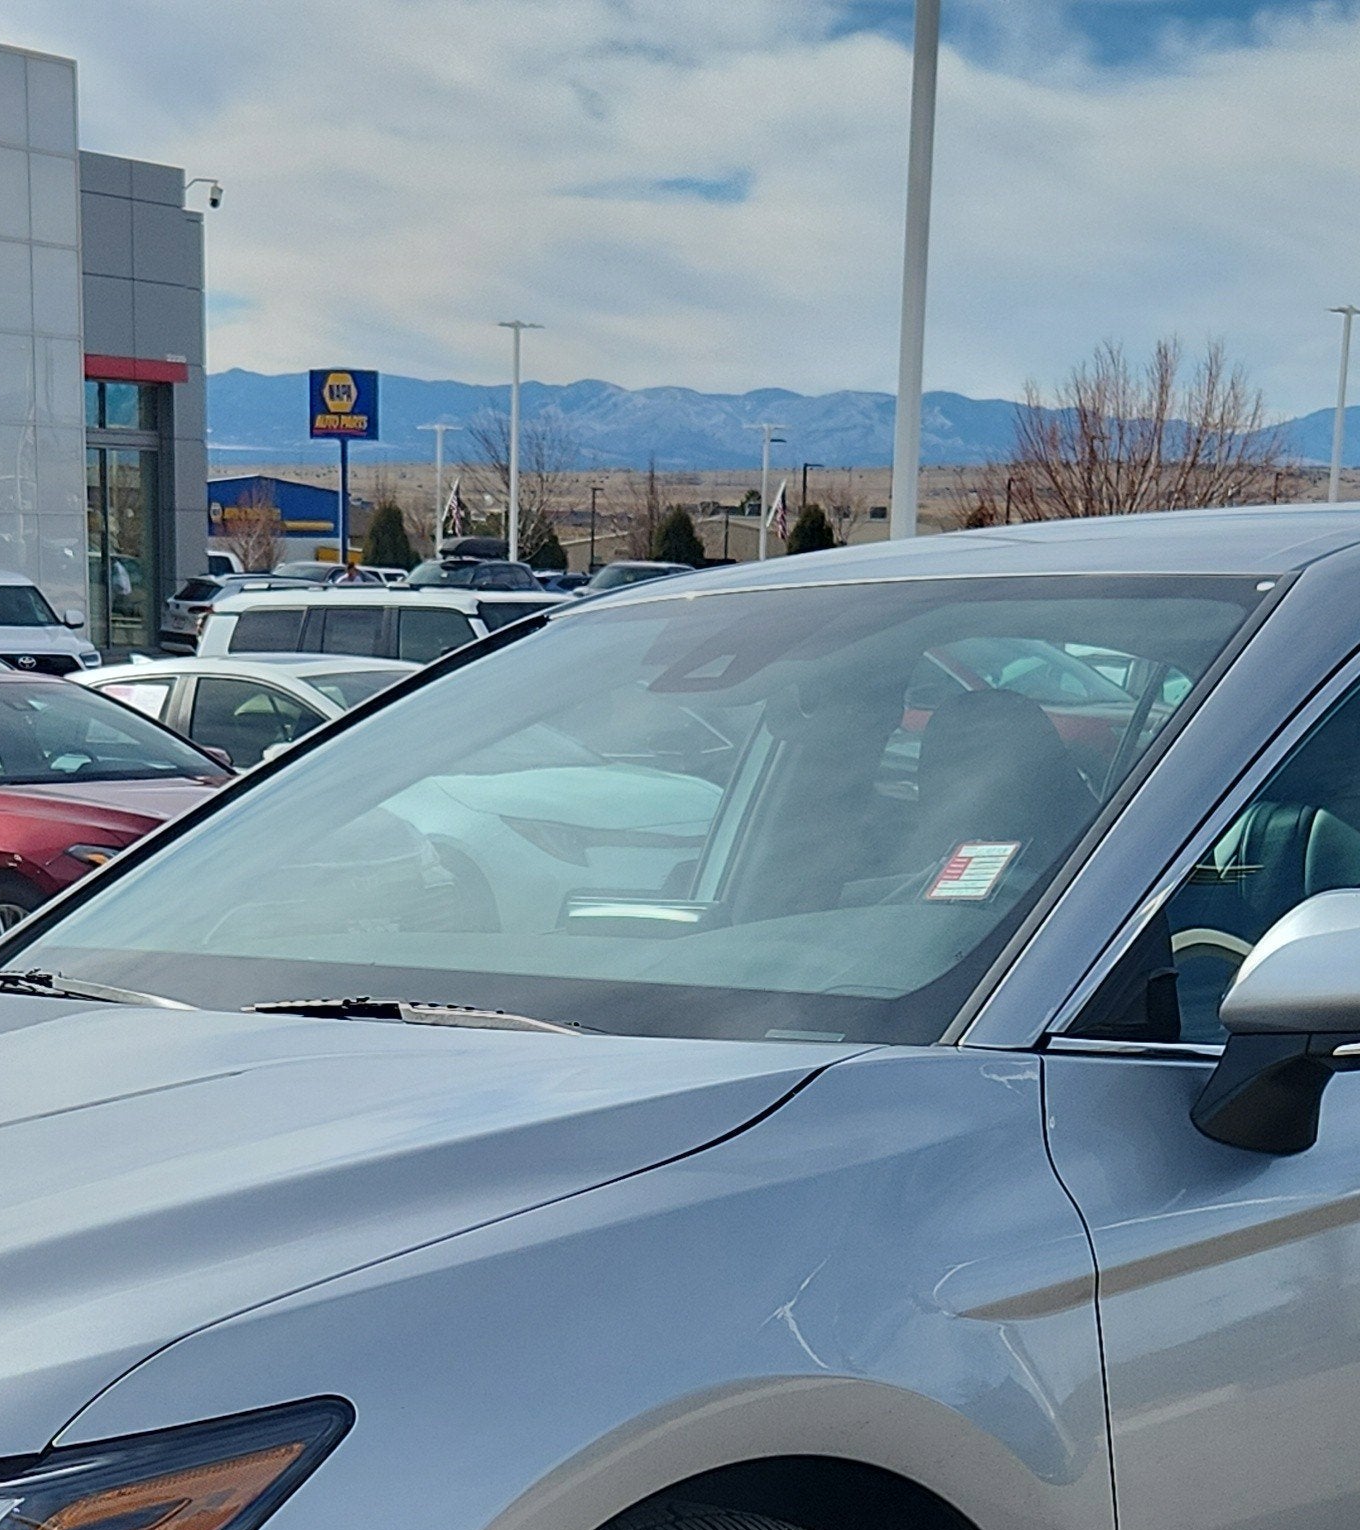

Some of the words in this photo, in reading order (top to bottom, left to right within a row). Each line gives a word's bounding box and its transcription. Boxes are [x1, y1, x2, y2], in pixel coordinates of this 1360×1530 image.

[328, 384, 352, 402] NAPA
[315, 414, 340, 430] AUTO
[340, 414, 368, 431] PARTS
